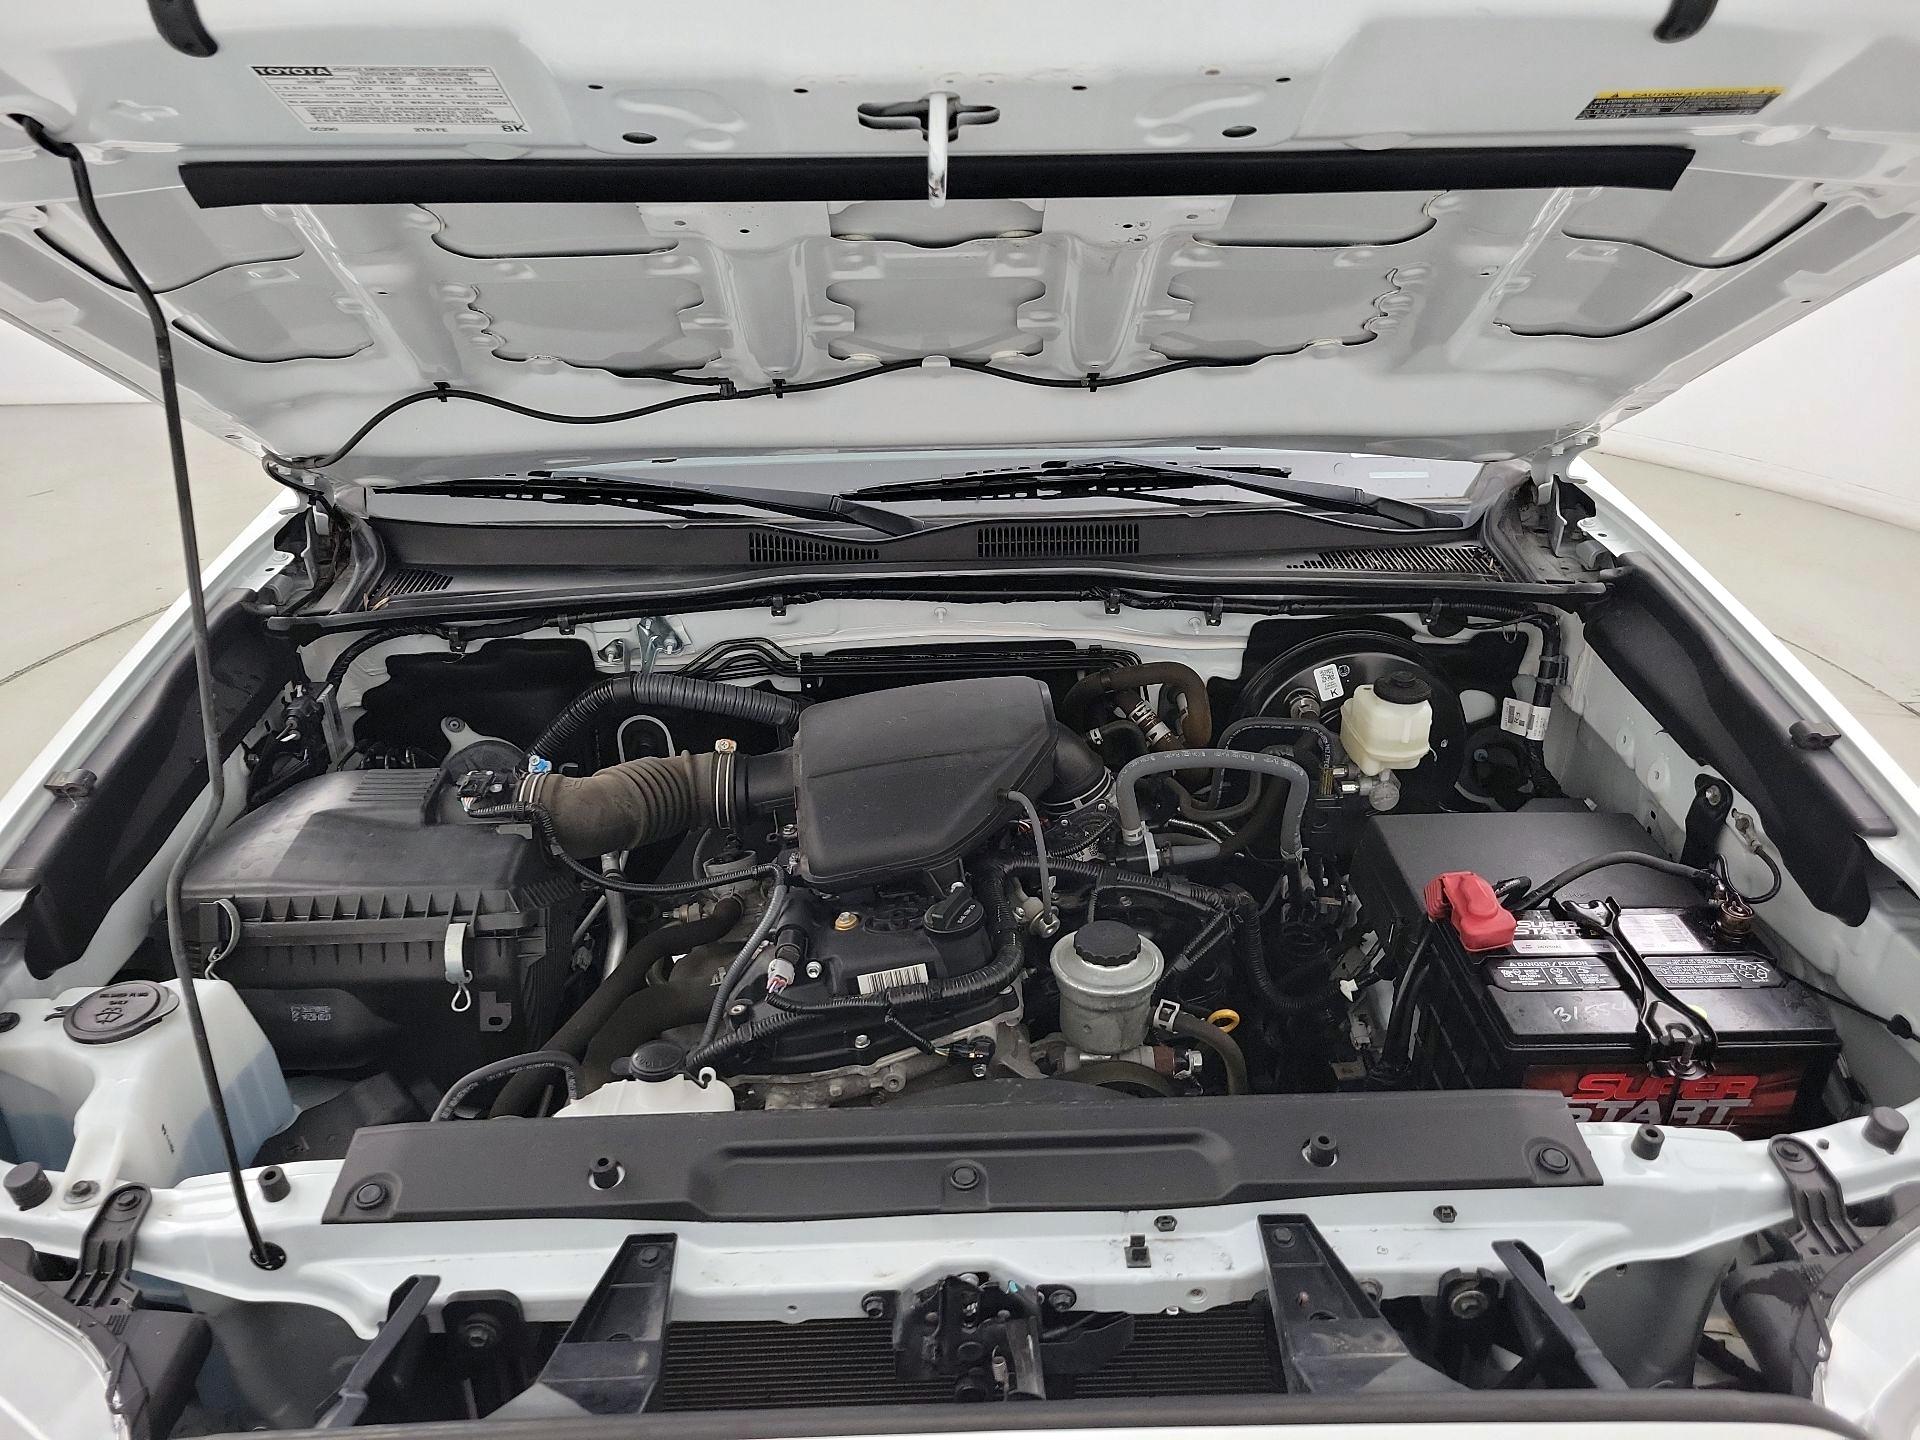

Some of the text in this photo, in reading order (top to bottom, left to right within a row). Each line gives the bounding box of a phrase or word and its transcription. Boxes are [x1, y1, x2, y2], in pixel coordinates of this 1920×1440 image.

[254, 67, 331, 76] TOYOTA
[501, 124, 529, 133] 8K
[1330, 688, 1339, 698] K
[1516, 920, 1578, 928] SUPER
[1514, 927, 1581, 935] START
[1572, 1073, 1759, 1100] SUPER
[1564, 1098, 1752, 1126] START
